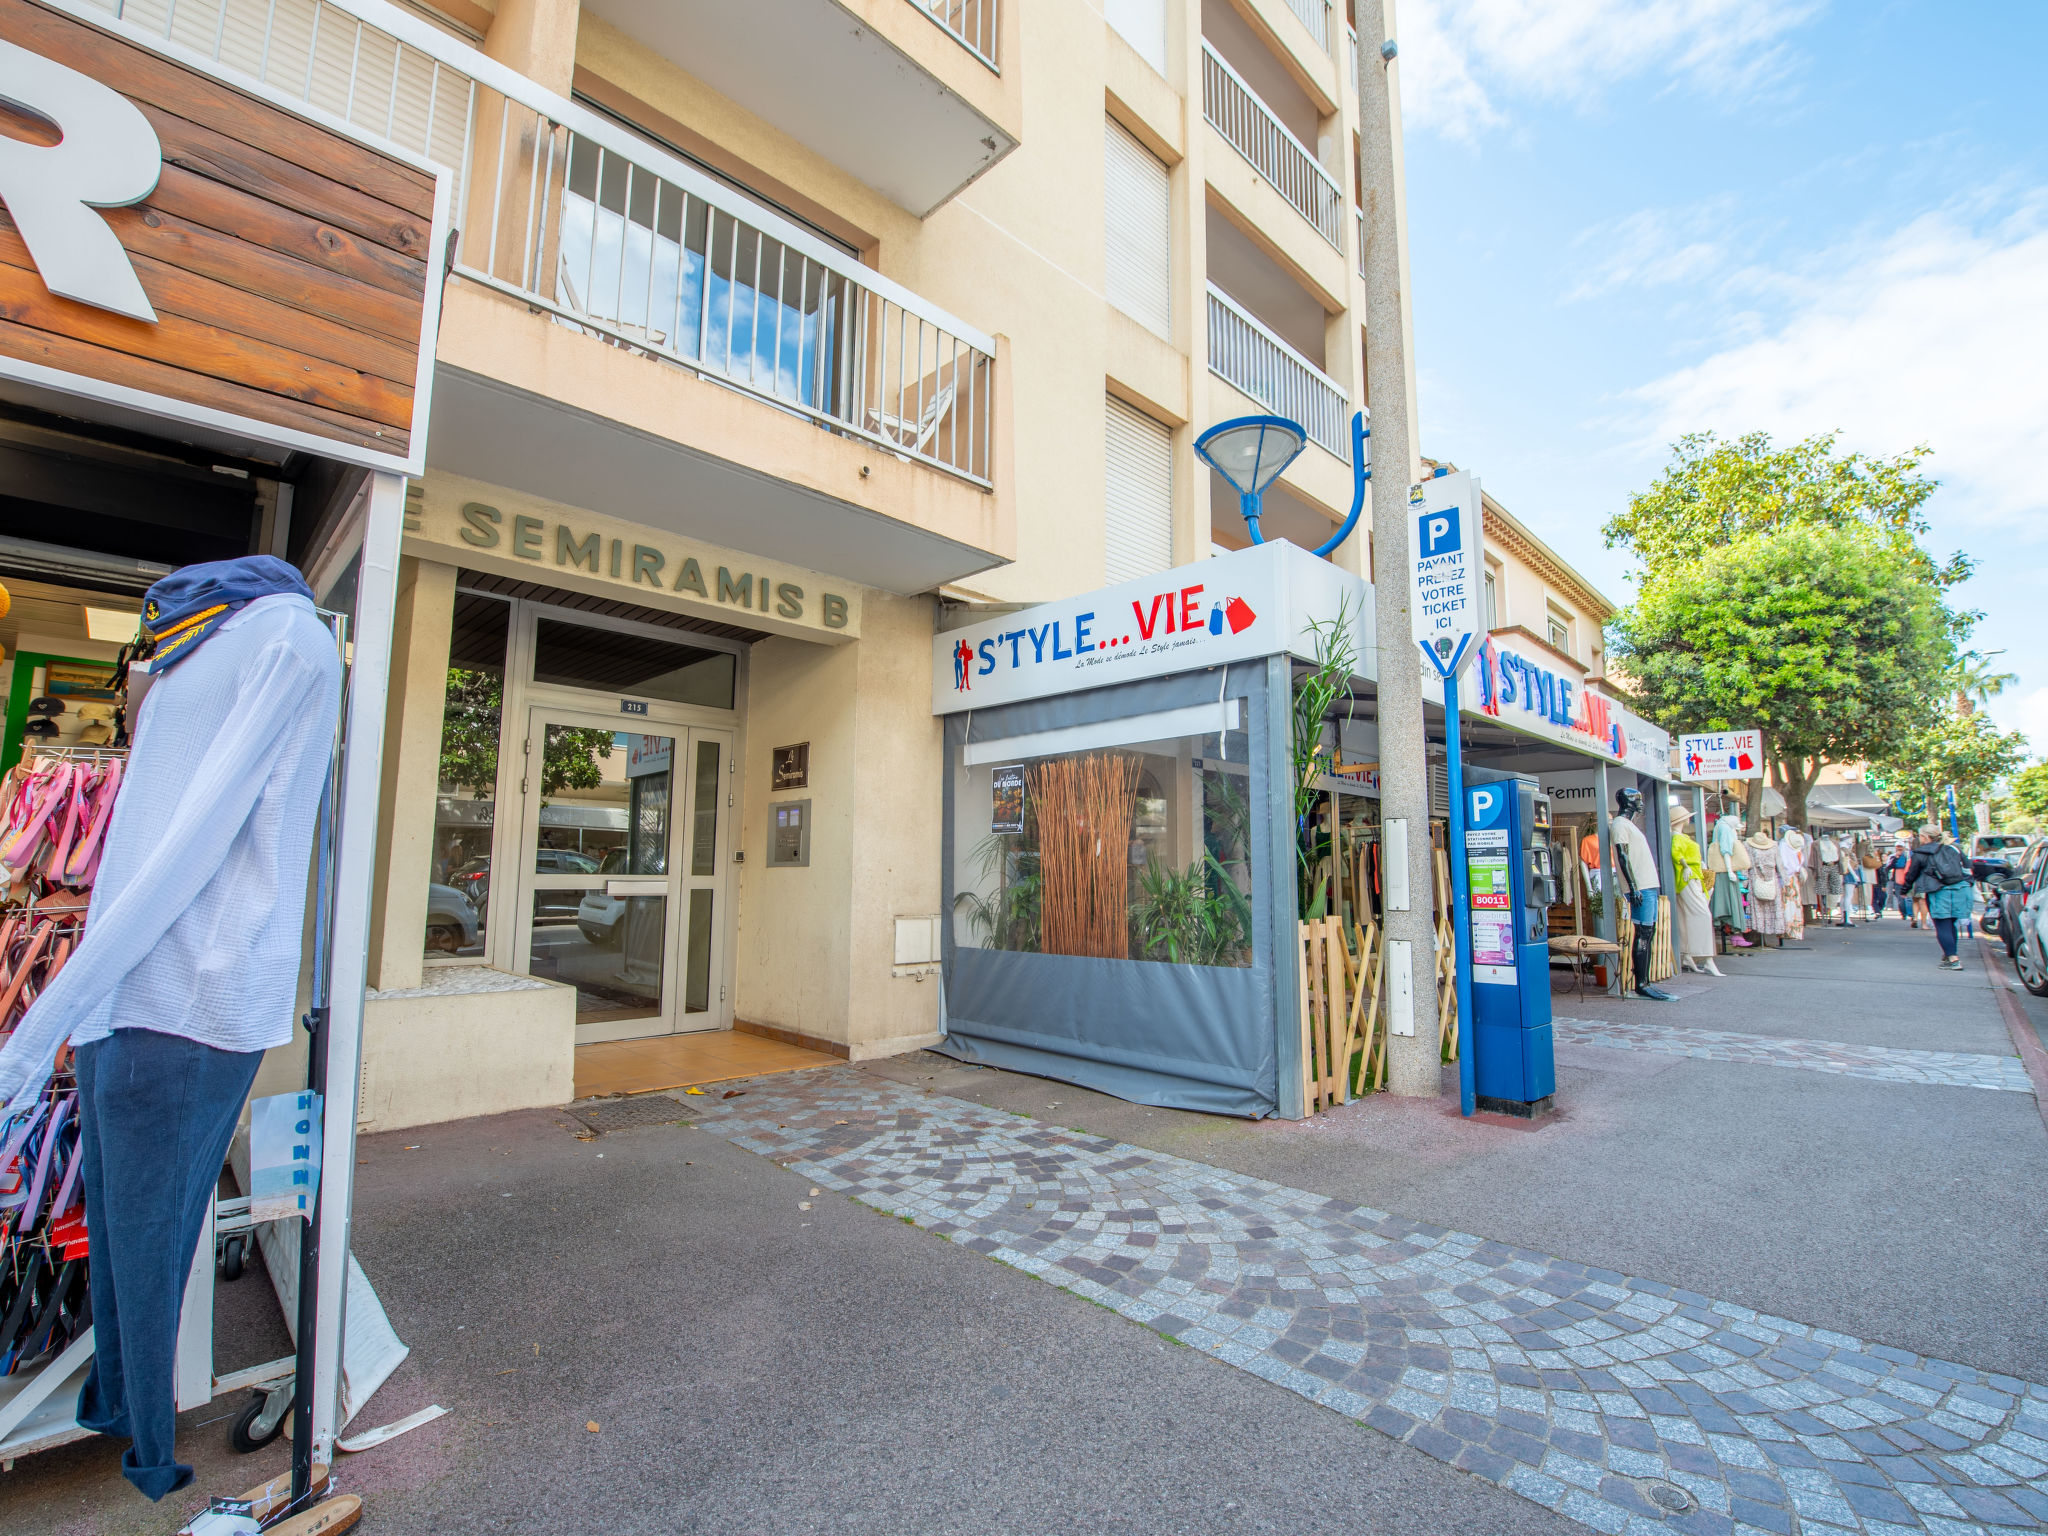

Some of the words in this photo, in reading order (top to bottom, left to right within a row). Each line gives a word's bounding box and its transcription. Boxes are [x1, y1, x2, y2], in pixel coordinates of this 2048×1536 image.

[0, 38, 162, 324] R
[1428, 517, 1450, 551] P
[460, 501, 804, 619] SEMIRAMIS
[824, 592, 849, 628] B
[1421, 584, 1464, 601] VOTRE
[1422, 598, 1466, 616] TICKET
[1436, 616, 1451, 629] ICI
[1086, 656, 1104, 667] Mode
[1150, 643, 1170, 656] Style
[627, 703, 642, 712] 215
[1472, 791, 1493, 821] P
